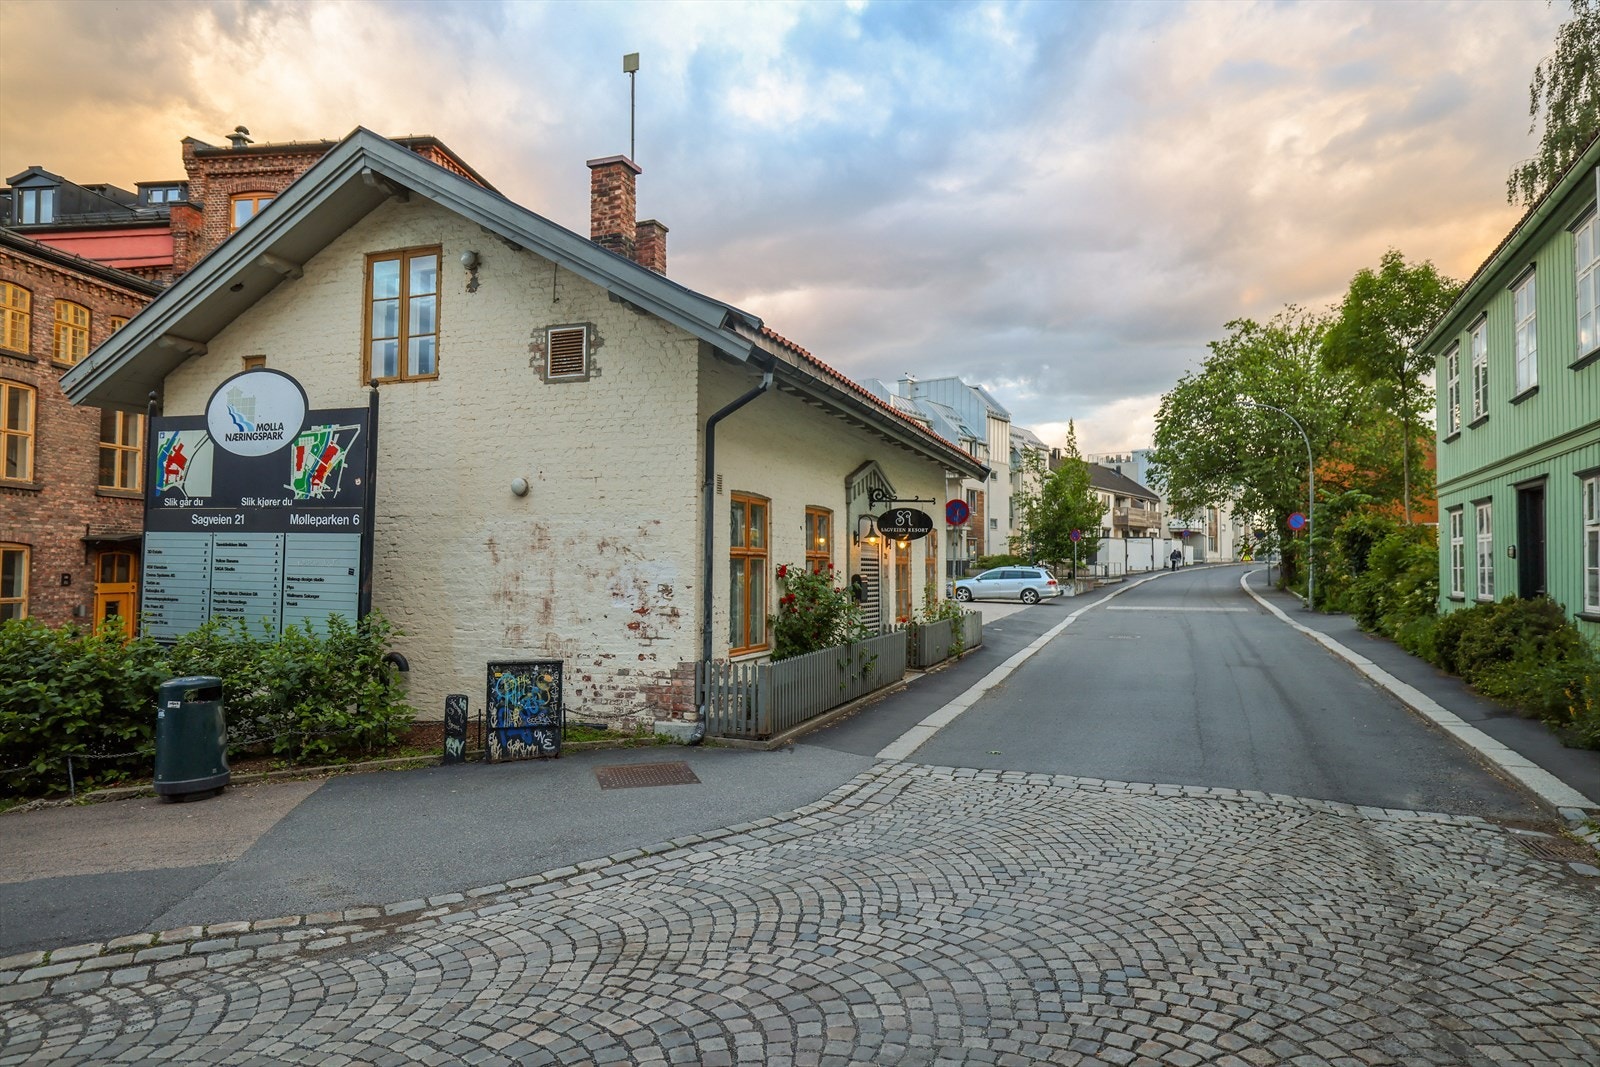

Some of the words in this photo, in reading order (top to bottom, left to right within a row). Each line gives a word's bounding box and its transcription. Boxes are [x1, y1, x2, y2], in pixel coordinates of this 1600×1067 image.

[255, 422, 284, 431] MØLLA
[225, 431, 283, 442] NÆRINGSPARK
[164, 497, 178, 506] Slik
[179, 497, 191, 508] går
[192, 498, 203, 506] du
[241, 497, 255, 506] Slik
[257, 497, 280, 508] kjører
[282, 497, 293, 506] du
[191, 514, 232, 526] Sagveien
[234, 514, 245, 524] 21
[290, 514, 349, 527] Mølleparken
[353, 514, 360, 524] 6
[60, 573, 72, 586] B
